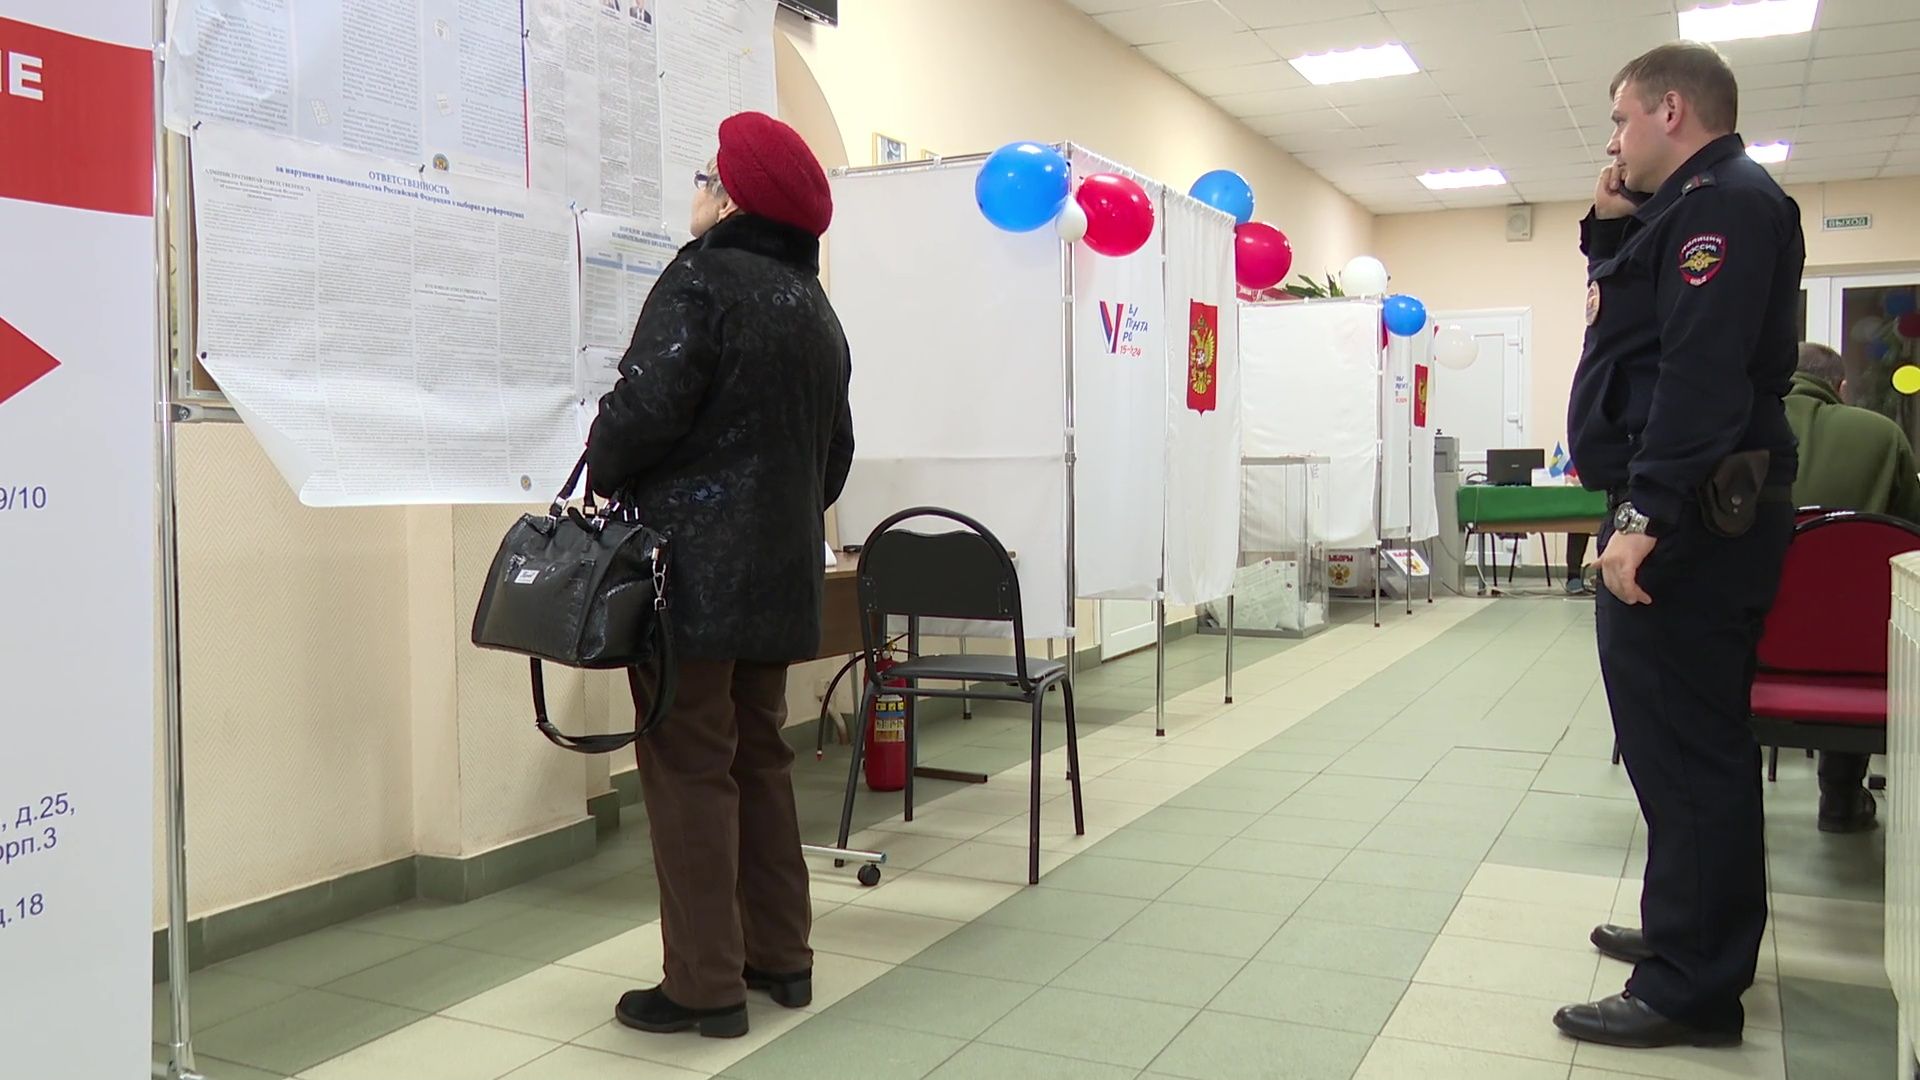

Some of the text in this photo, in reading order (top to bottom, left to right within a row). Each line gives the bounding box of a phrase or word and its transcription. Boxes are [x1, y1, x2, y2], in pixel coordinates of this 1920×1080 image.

[0, 49, 44, 101] Е
[285, 167, 325, 181] нарушение
[326, 175, 383, 192] законодательства
[383, 185, 419, 199] Российской
[368, 170, 450, 195] ОТВЕТСТВЕННОСТЬ
[1685, 244, 1717, 259] РОССИЯ
[15, 792, 75, 829] д.25,
